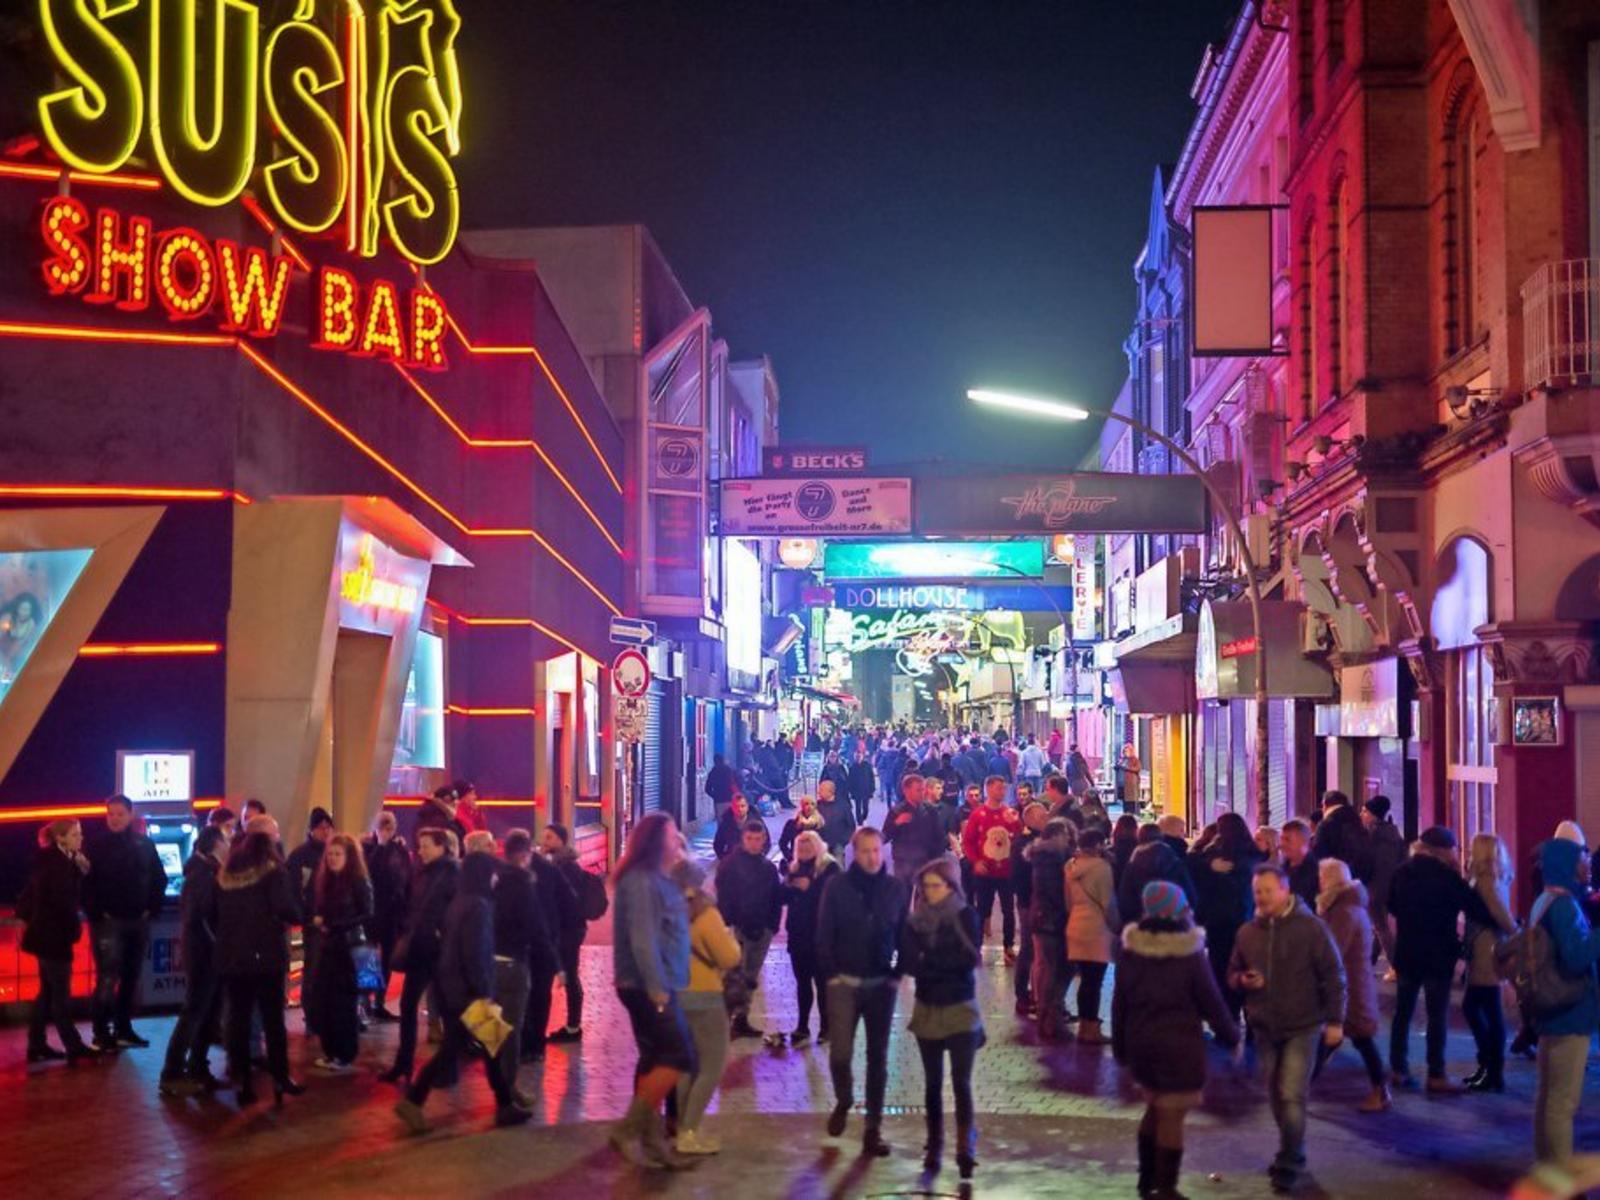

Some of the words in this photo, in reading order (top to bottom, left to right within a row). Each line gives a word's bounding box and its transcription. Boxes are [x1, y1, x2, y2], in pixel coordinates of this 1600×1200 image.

[41, 196, 293, 336] SHOW
[316, 266, 448, 370] BAR
[791, 452, 865, 469] BECK'S
[847, 588, 968, 608] DOLLHOUSE
